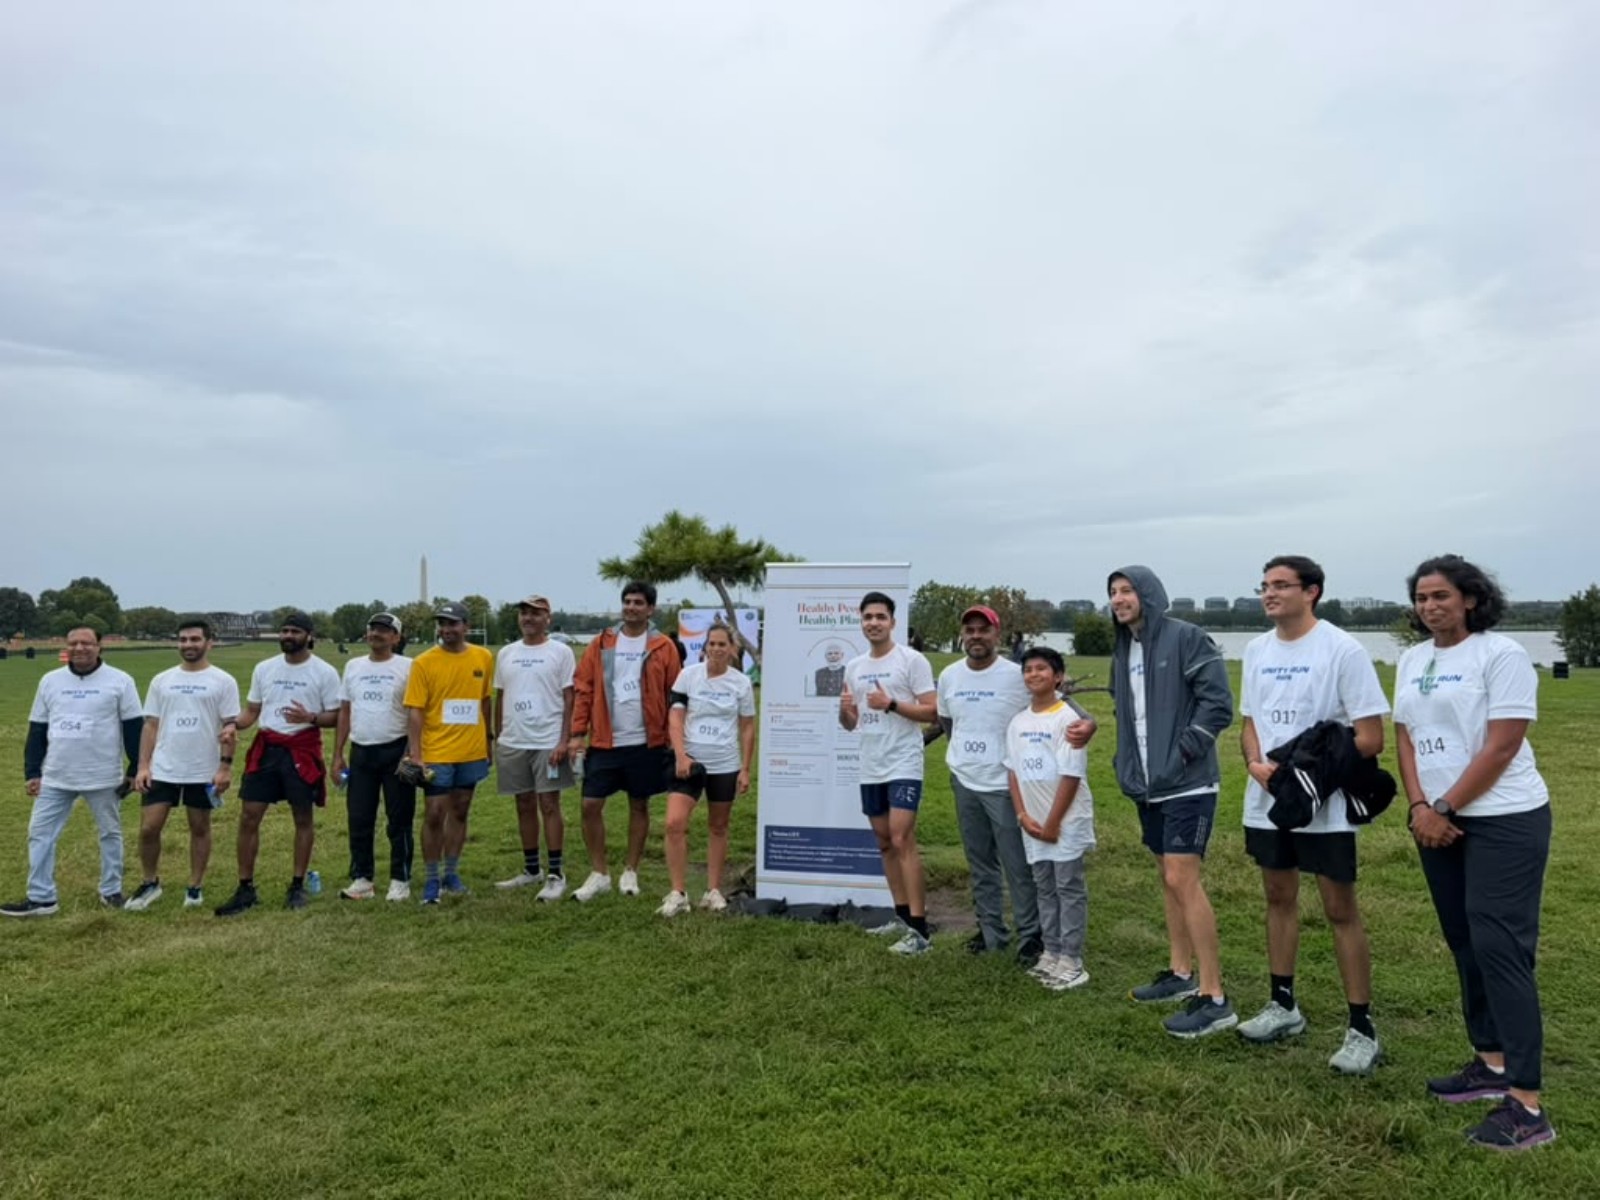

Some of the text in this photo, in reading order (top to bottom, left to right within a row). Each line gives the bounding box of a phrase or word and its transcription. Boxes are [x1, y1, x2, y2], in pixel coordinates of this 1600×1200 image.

[797, 602, 863, 616] Healthy Peop
[799, 614, 863, 627] Healthy Plan
[1437, 673, 1463, 681] RUN
[514, 700, 532, 713] 001
[176, 717, 199, 727] 007
[1271, 708, 1298, 725] 017
[963, 740, 987, 754] 009
[1417, 736, 1446, 757] 014
